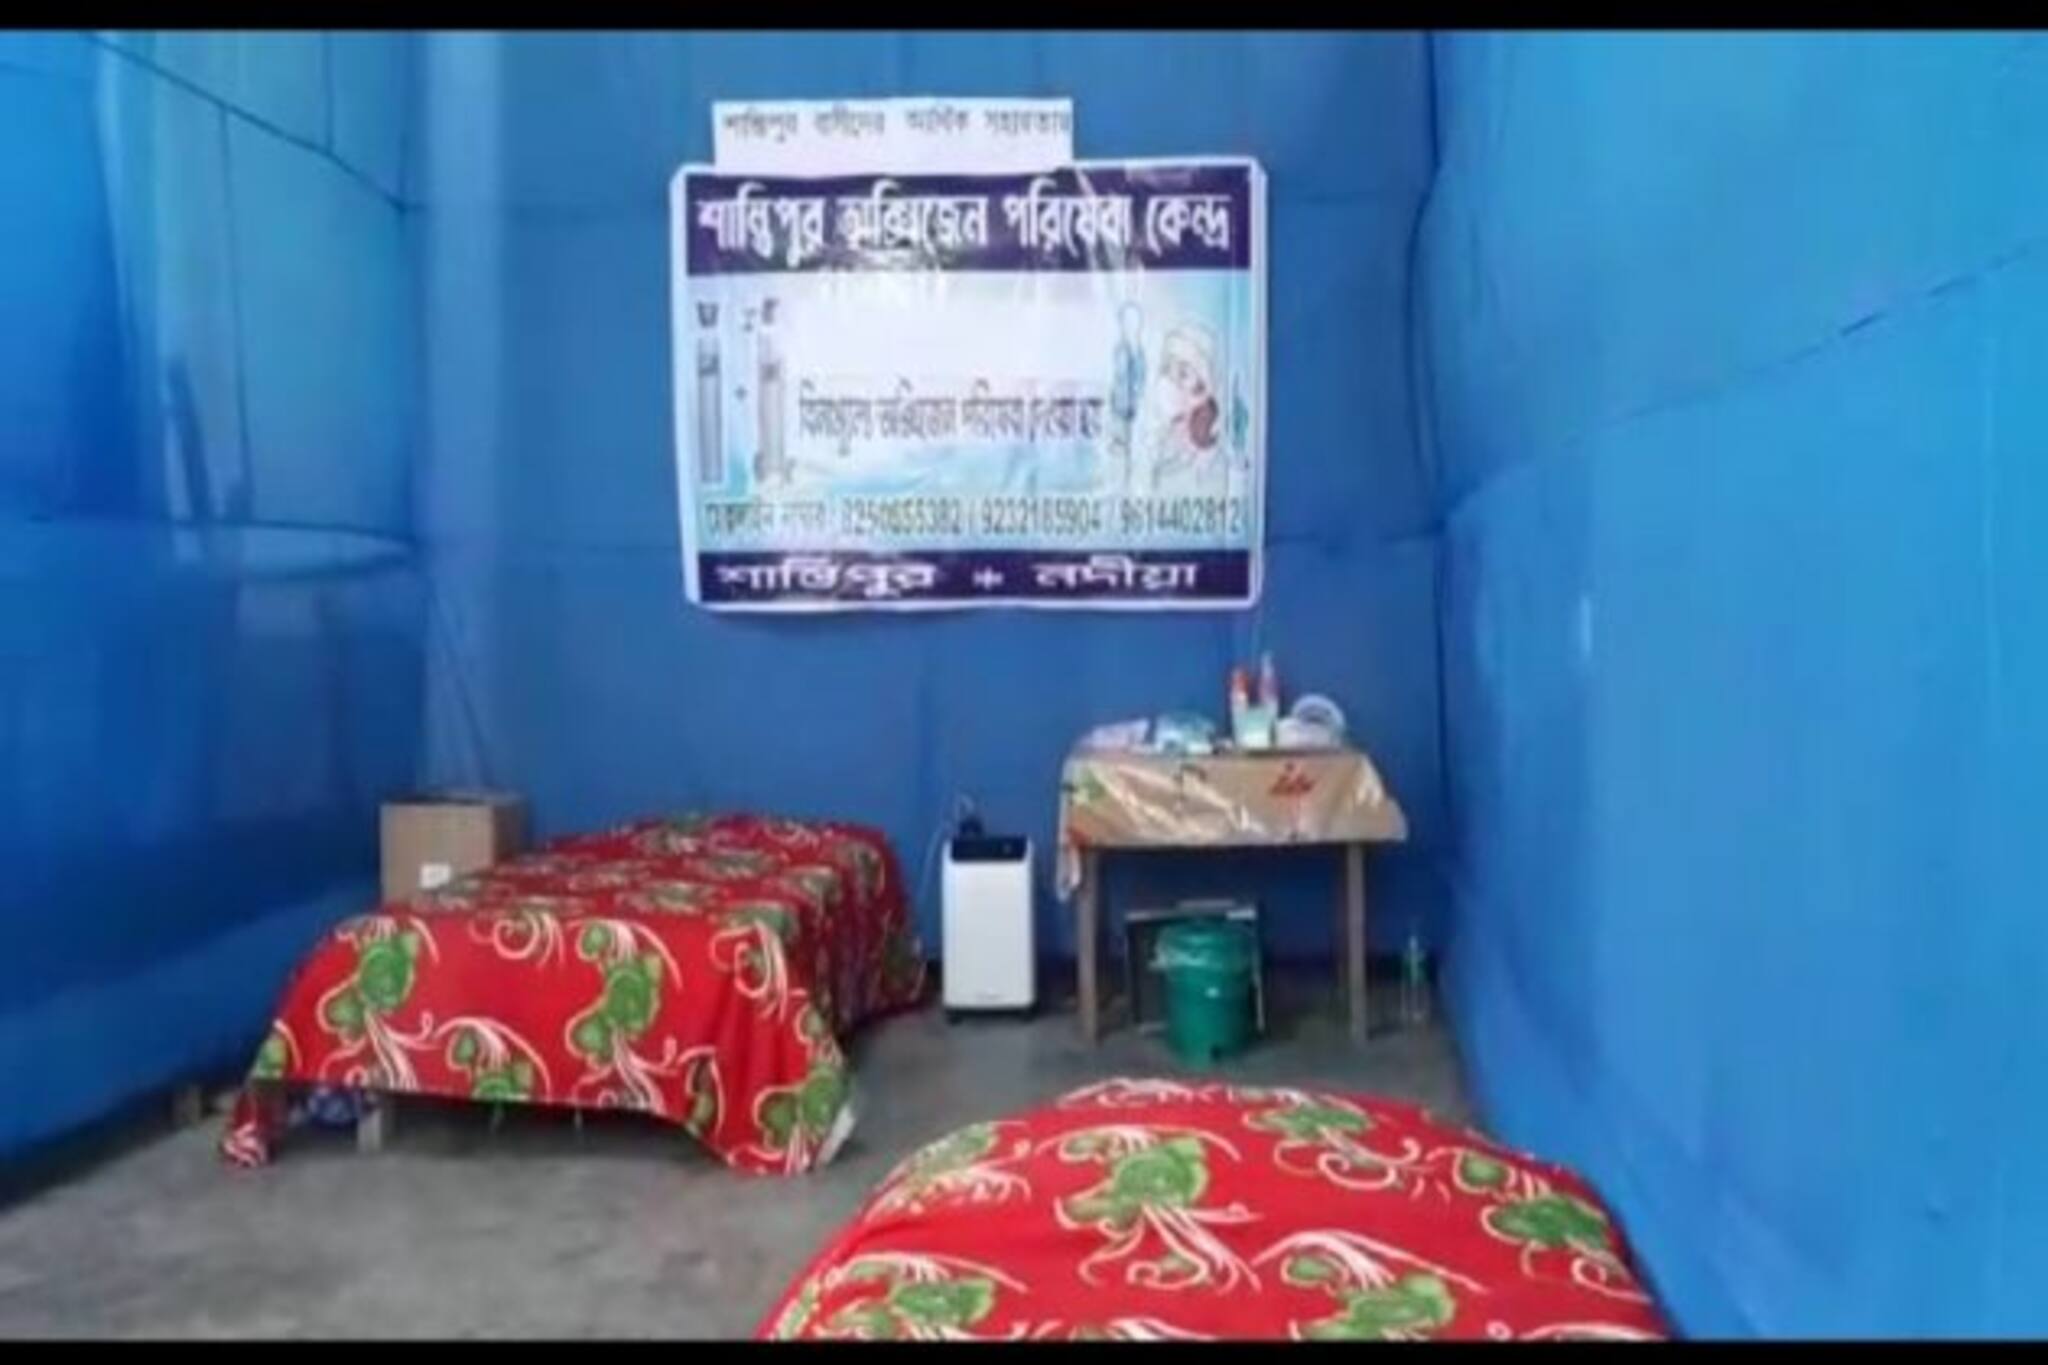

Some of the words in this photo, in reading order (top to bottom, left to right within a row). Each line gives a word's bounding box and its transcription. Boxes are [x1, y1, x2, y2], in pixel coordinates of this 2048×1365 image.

[698, 182, 826, 268] শান্তিপুর
[837, 183, 989, 251] অক্সিজেন
[1001, 181, 1134, 251] পরিষেবা
[1145, 192, 1231, 252] কেন্দ্র
[717, 556, 937, 598] শান্তিপুর
[1033, 555, 1199, 591] নদীয়া
